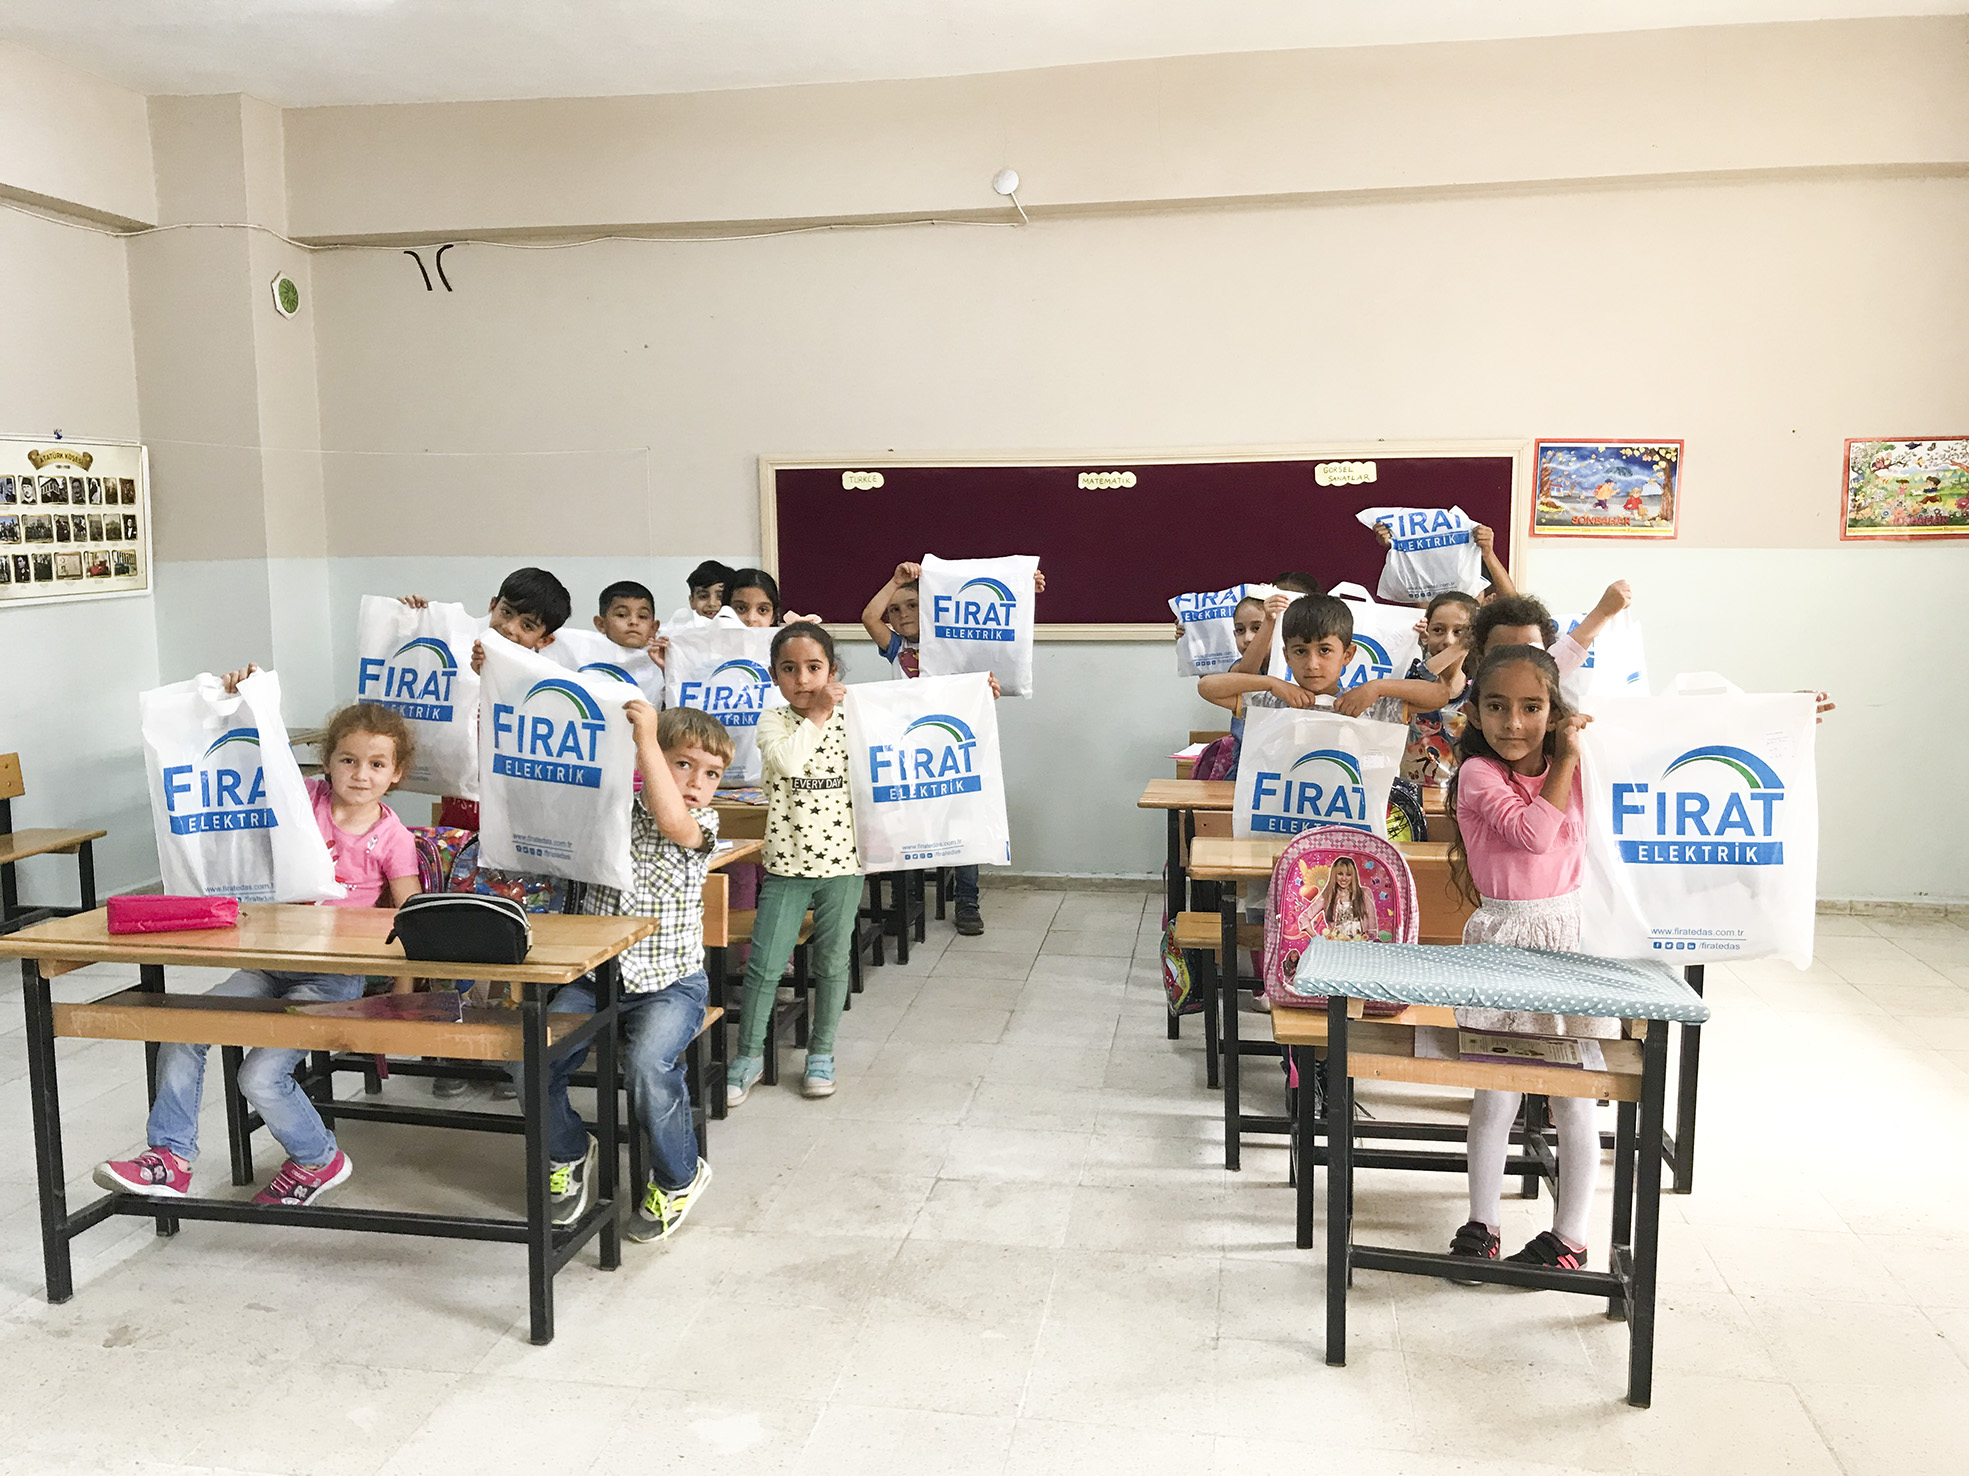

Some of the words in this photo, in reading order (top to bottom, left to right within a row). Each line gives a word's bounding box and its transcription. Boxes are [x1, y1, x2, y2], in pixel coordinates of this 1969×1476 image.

[1328, 474, 1370, 482] SANATLAR
[934, 596, 1016, 626] FIRAT
[1185, 606, 1237, 621] ELEKTRİ
[945, 628, 1002, 640] ELEKTRİK
[359, 657, 457, 702] FIRAT
[679, 682, 771, 711] FIRAT
[494, 703, 606, 762] FIRAT
[505, 760, 585, 784] ELEKTRİK
[869, 741, 977, 783] FIRAT
[163, 764, 267, 812] FIRA
[794, 779, 823, 788] EVERY
[826, 779, 842, 788] DAY
[889, 778, 965, 800] ELEKTRİK
[1252, 771, 1366, 821] FIRAT
[188, 808, 268, 832] ELEKTRİ
[1612, 783, 1784, 837] FIRAT
[1638, 842, 1758, 863] ELEKTRİK
[1650, 927, 1744, 937] www.firatedas.com.tr
[1698, 941, 1741, 950] /firatedas
